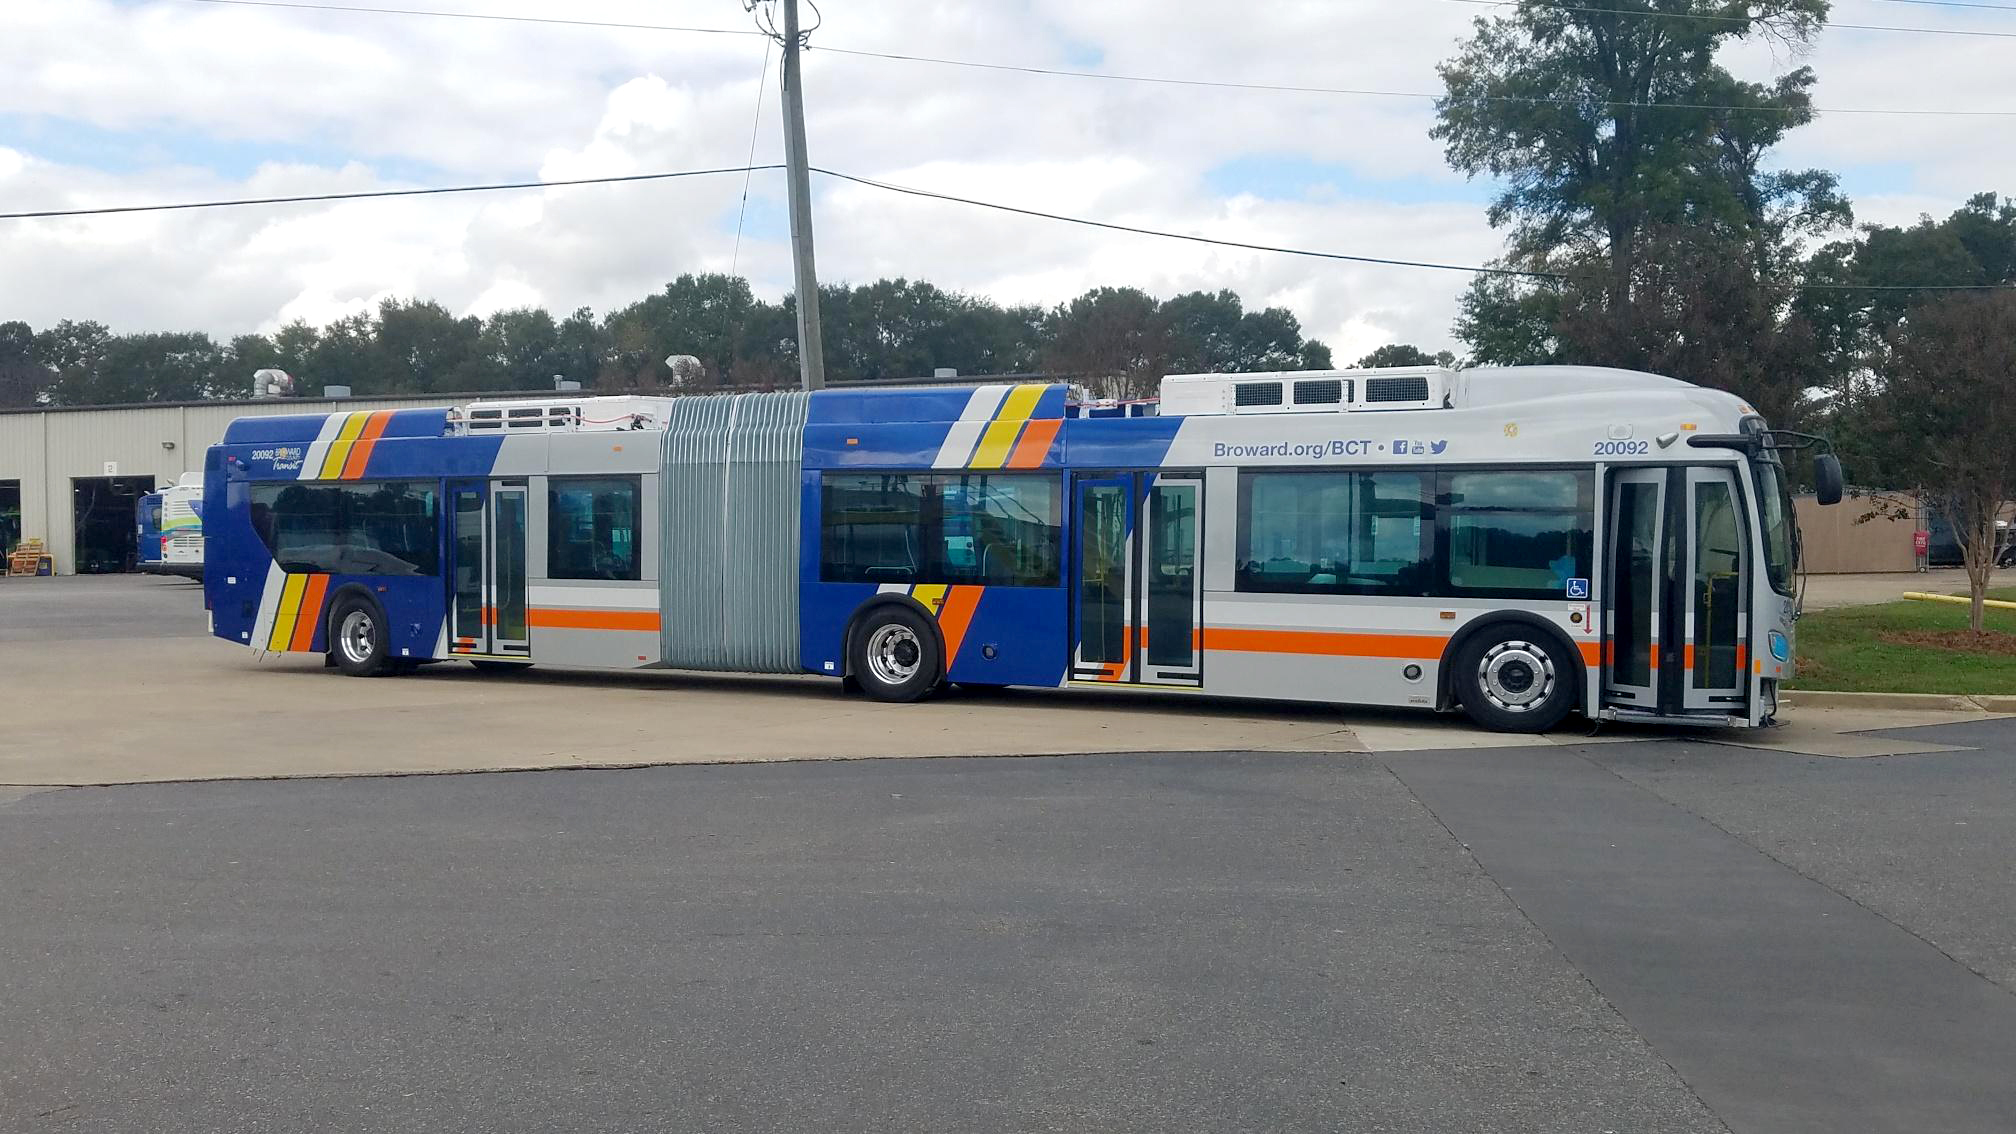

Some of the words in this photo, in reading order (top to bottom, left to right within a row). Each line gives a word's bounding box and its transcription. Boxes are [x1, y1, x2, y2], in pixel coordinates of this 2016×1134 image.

[251, 449, 274, 460] 20092
[1214, 440, 1372, 459] Broward.org/BCT
[1593, 441, 1649, 455] 20092
[272, 456, 304, 471] Transit
